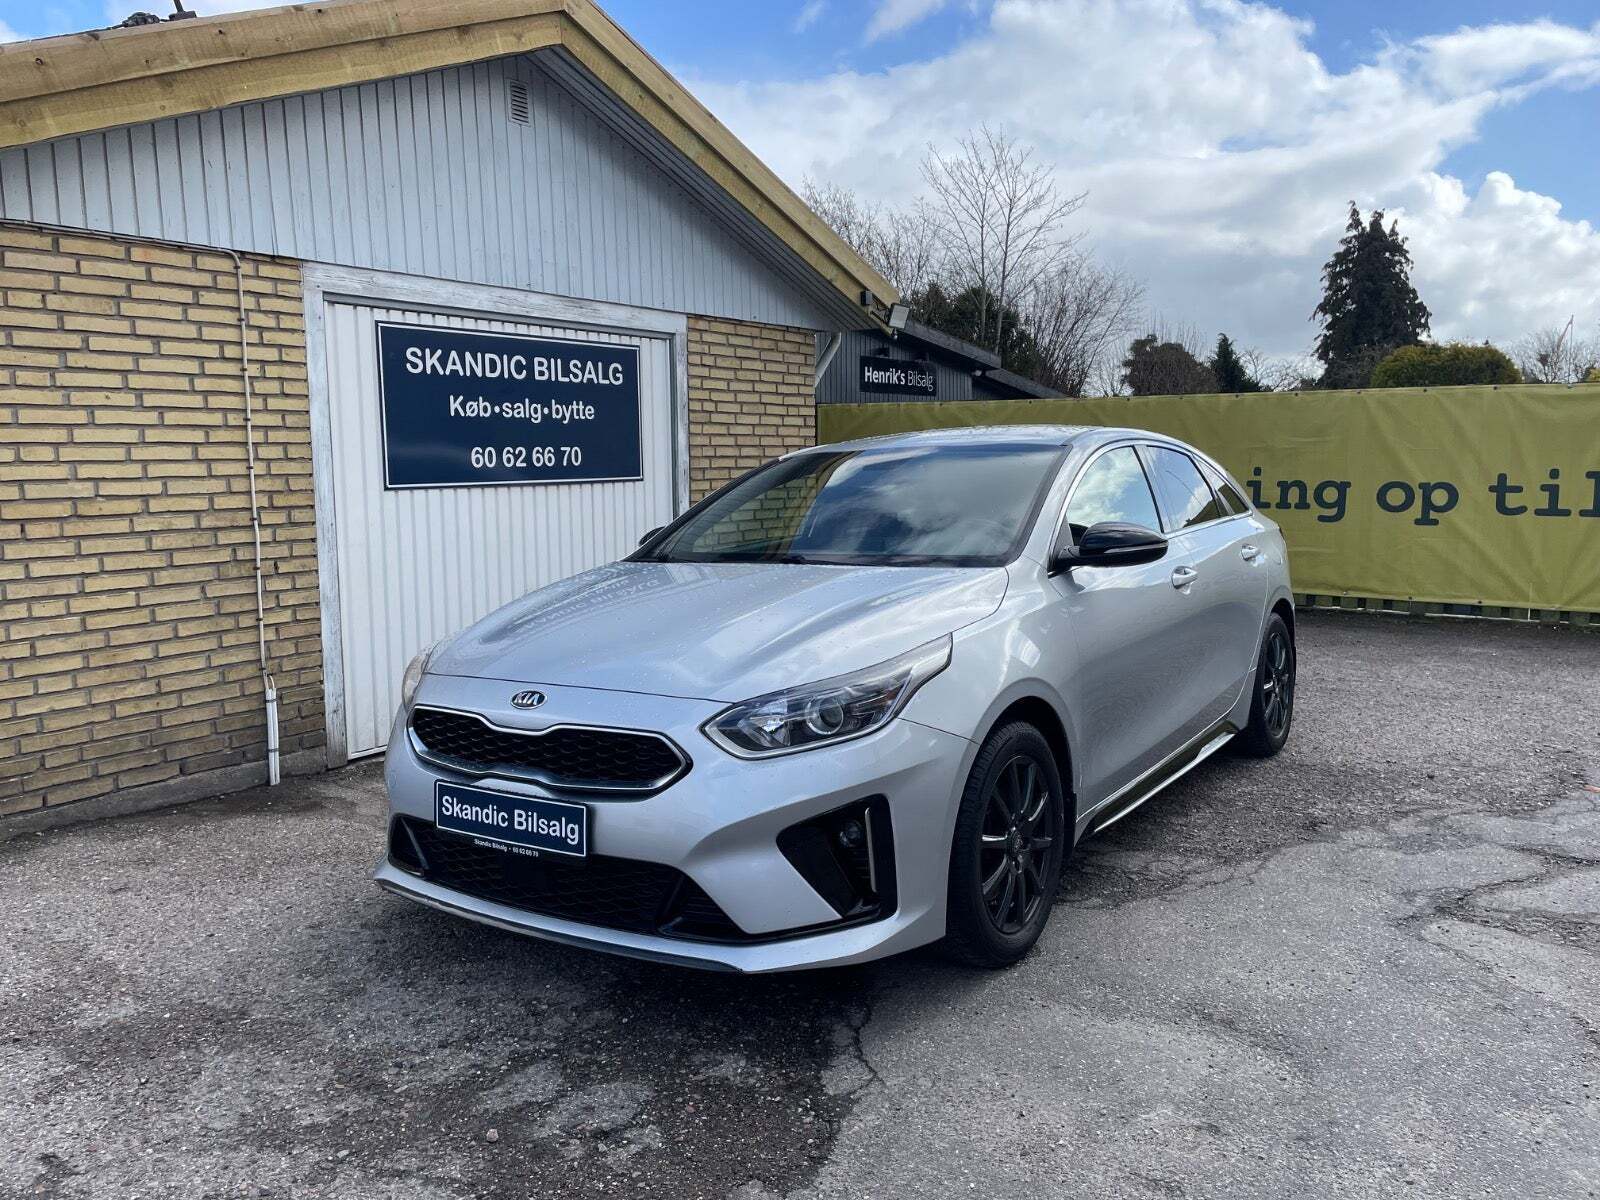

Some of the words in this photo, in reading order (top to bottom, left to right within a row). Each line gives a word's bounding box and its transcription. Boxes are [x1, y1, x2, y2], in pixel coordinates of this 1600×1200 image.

[405, 346, 527, 379] SKANDIC
[533, 356, 623, 386] BILSALG
[864, 366, 905, 385] Henrik's
[907, 370, 934, 391] Bilsalg
[470, 446, 497, 468] 60
[502, 446, 527, 468] 62
[532, 446, 556, 467] 66
[560, 446, 582, 467] 70
[1247, 466, 1352, 523] ing
[1376, 480, 1460, 526] op
[513, 691, 541, 706] KIA
[441, 795, 509, 828] Skandic
[514, 808, 579, 845] Bilsalg
